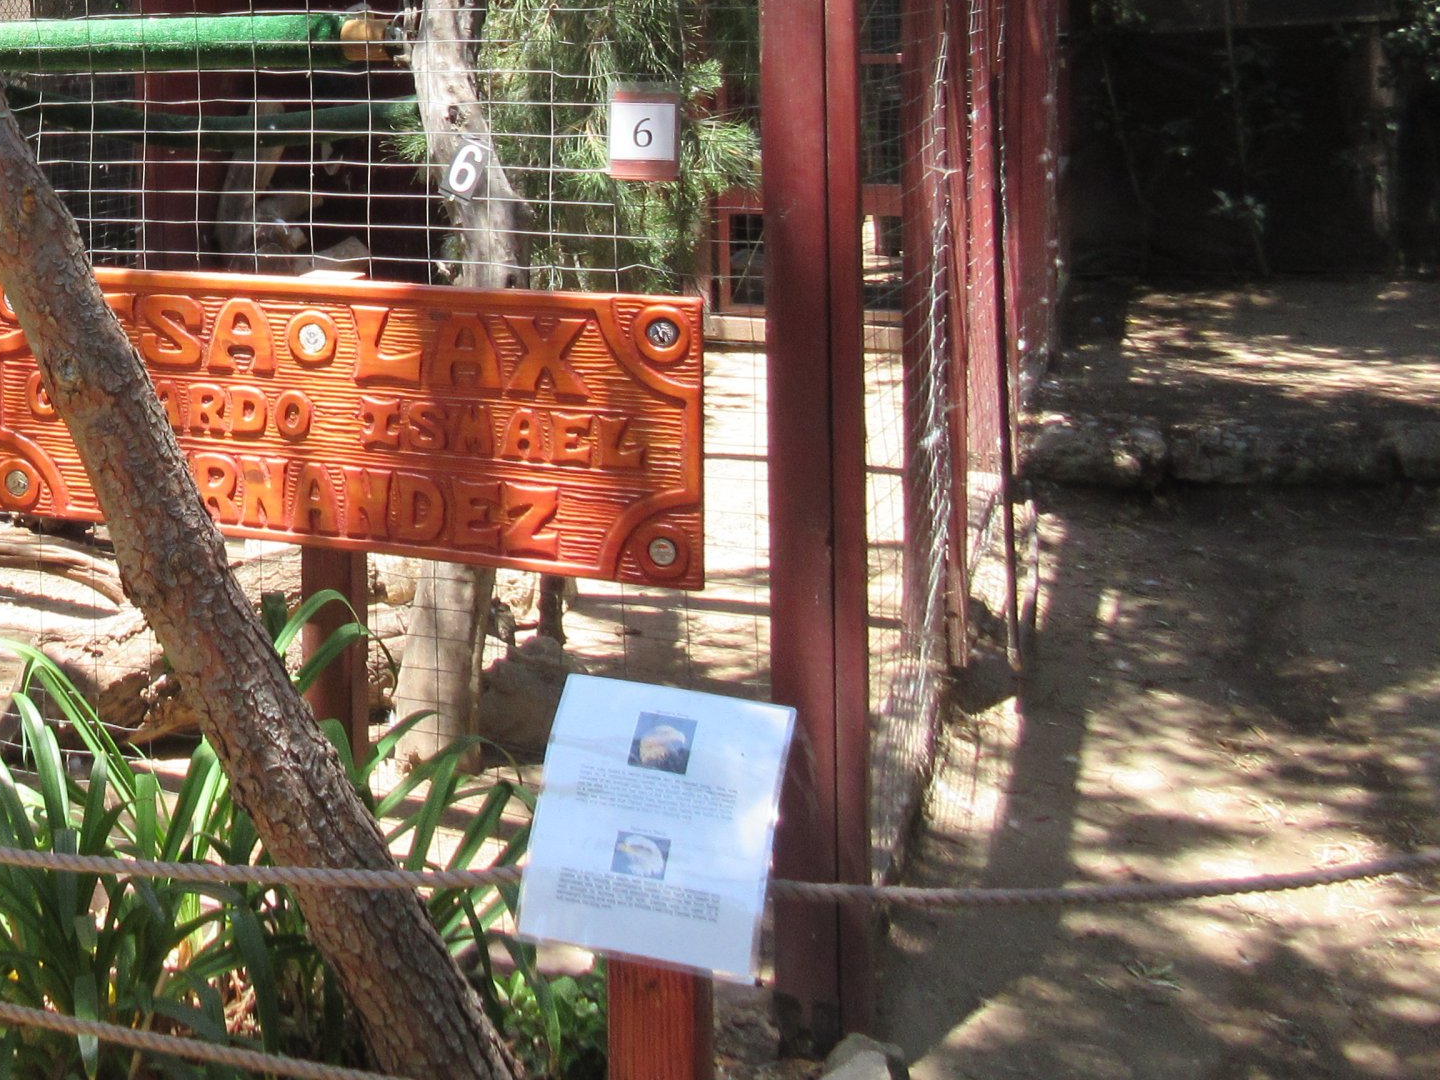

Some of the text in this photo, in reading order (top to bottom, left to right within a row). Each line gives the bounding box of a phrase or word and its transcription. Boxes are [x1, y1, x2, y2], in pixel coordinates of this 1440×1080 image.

[448, 143, 483, 193] 6
[631, 116, 654, 148] 6
[103, 294, 594, 404] SA LAX
[359, 393, 648, 470] ISMAEL
[187, 450, 559, 560] RNANDEZ
